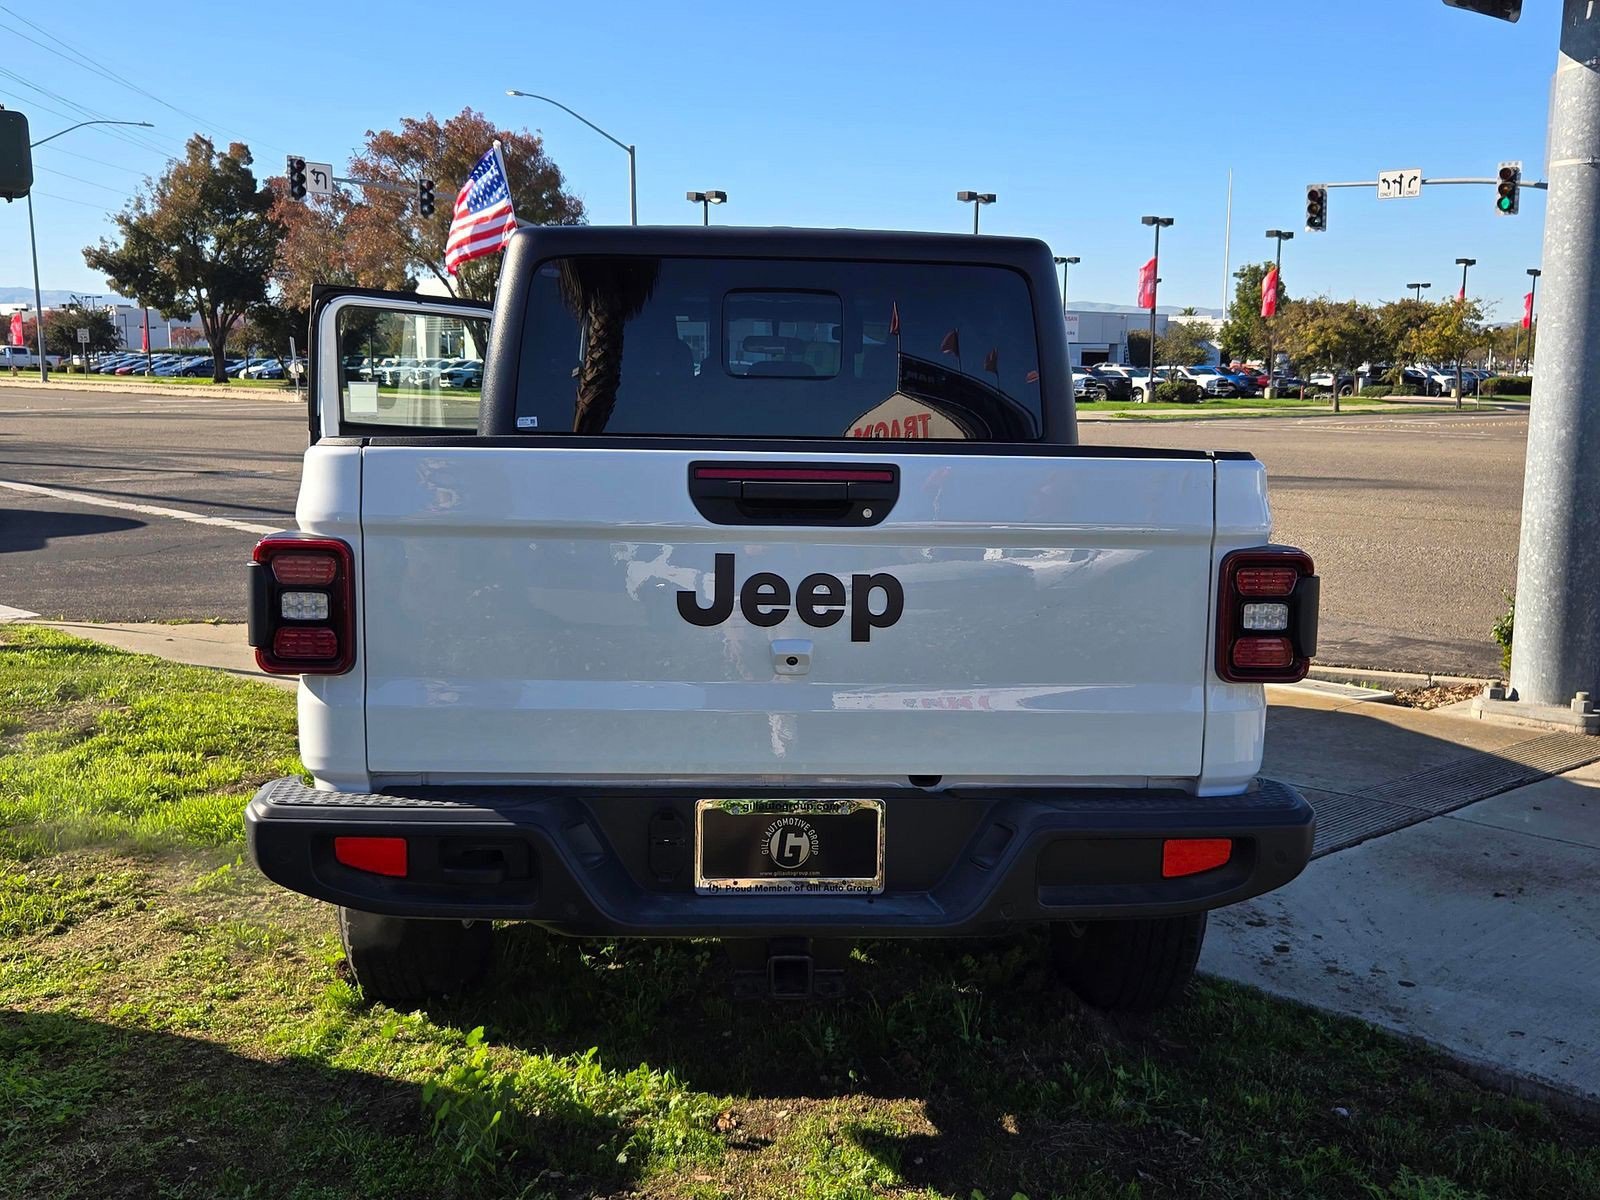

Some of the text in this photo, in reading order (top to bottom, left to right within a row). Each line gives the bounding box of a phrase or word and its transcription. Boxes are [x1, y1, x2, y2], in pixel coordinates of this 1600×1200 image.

[677, 553, 904, 642] Jeep
[760, 817, 820, 856] GILL AUTOMOTIVE GROUP
[726, 884, 750, 892] Proud
[755, 884, 793, 892] Member
[795, 884, 804, 892] of
[806, 884, 821, 892] Gill
[823, 884, 844, 892] Auto
[846, 884, 874, 894] Group
